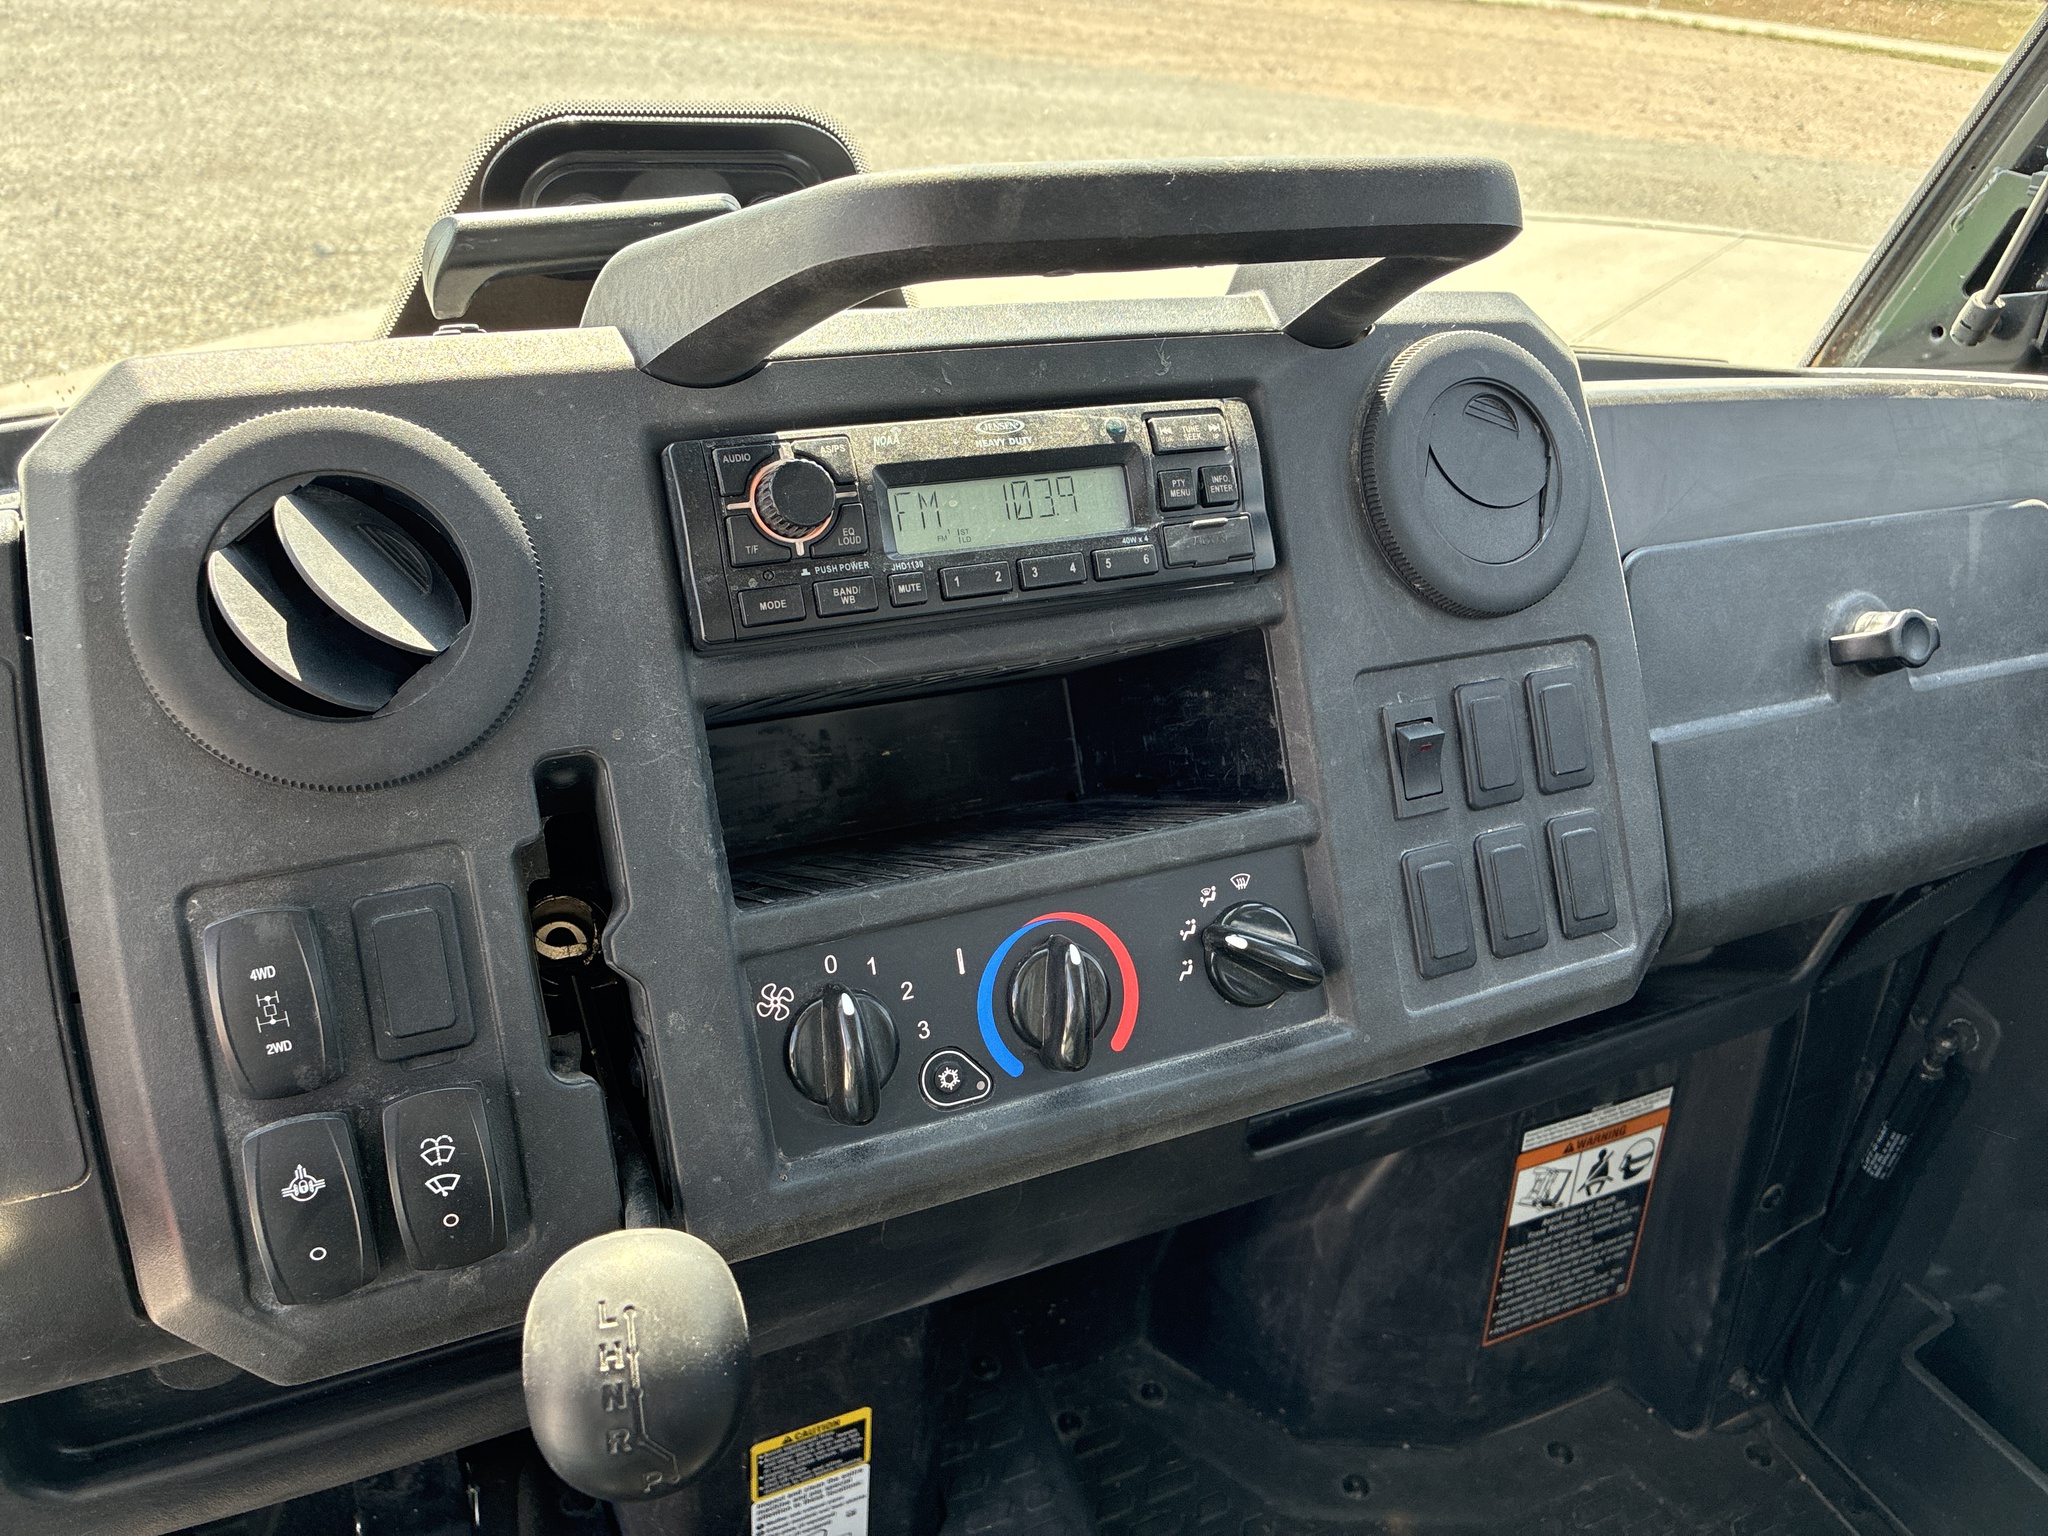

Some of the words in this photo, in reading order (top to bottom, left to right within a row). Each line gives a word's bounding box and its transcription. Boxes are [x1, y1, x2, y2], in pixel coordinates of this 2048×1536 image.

[1182, 424, 1200, 433] TUNE
[873, 433, 900, 448] NOAA
[975, 438, 1005, 448] HEAVY
[1008, 436, 1033, 446] DUTY
[1183, 432, 1201, 440] SEEK
[820, 443, 846, 454] AS/PS
[722, 452, 751, 463] AUDIO
[1171, 479, 1185, 487] PTY
[1210, 484, 1233, 493] ENTER
[1170, 488, 1191, 498] MENU
[894, 490, 942, 533] FM
[842, 528, 856, 538] EQ
[838, 535, 861, 546] LOUD
[1122, 536, 1137, 545] 40W
[1143, 535, 1149, 543] 4
[745, 545, 759, 555] T/F
[1105, 557, 1112, 569] 5
[1143, 552, 1150, 565] 6
[814, 565, 838, 575] PUSH
[839, 561, 870, 573] POWER
[891, 560, 924, 572] JHD1130
[1031, 566, 1039, 578] 3
[1069, 562, 1077, 574] 4
[954, 576, 960, 588] 1
[995, 571, 1002, 583] 2
[833, 585, 861, 597] BAND/
[898, 582, 922, 594] MUTE
[759, 600, 787, 611] MODE
[840, 595, 856, 605] WB
[825, 953, 838, 974] 0
[867, 956, 877, 976] 1
[250, 964, 276, 981] 4WD
[900, 981, 915, 1001] 2
[918, 1020, 931, 1040] 3
[266, 1039, 292, 1056] 2WD
[1576, 1124, 1627, 1150] WARNING
[598, 1300, 619, 1329] L
[599, 1340, 625, 1372] H
[601, 1381, 628, 1413] N
[794, 1418, 841, 1441] CAUTION
[606, 1427, 632, 1455] R
[643, 1469, 663, 1494] P
